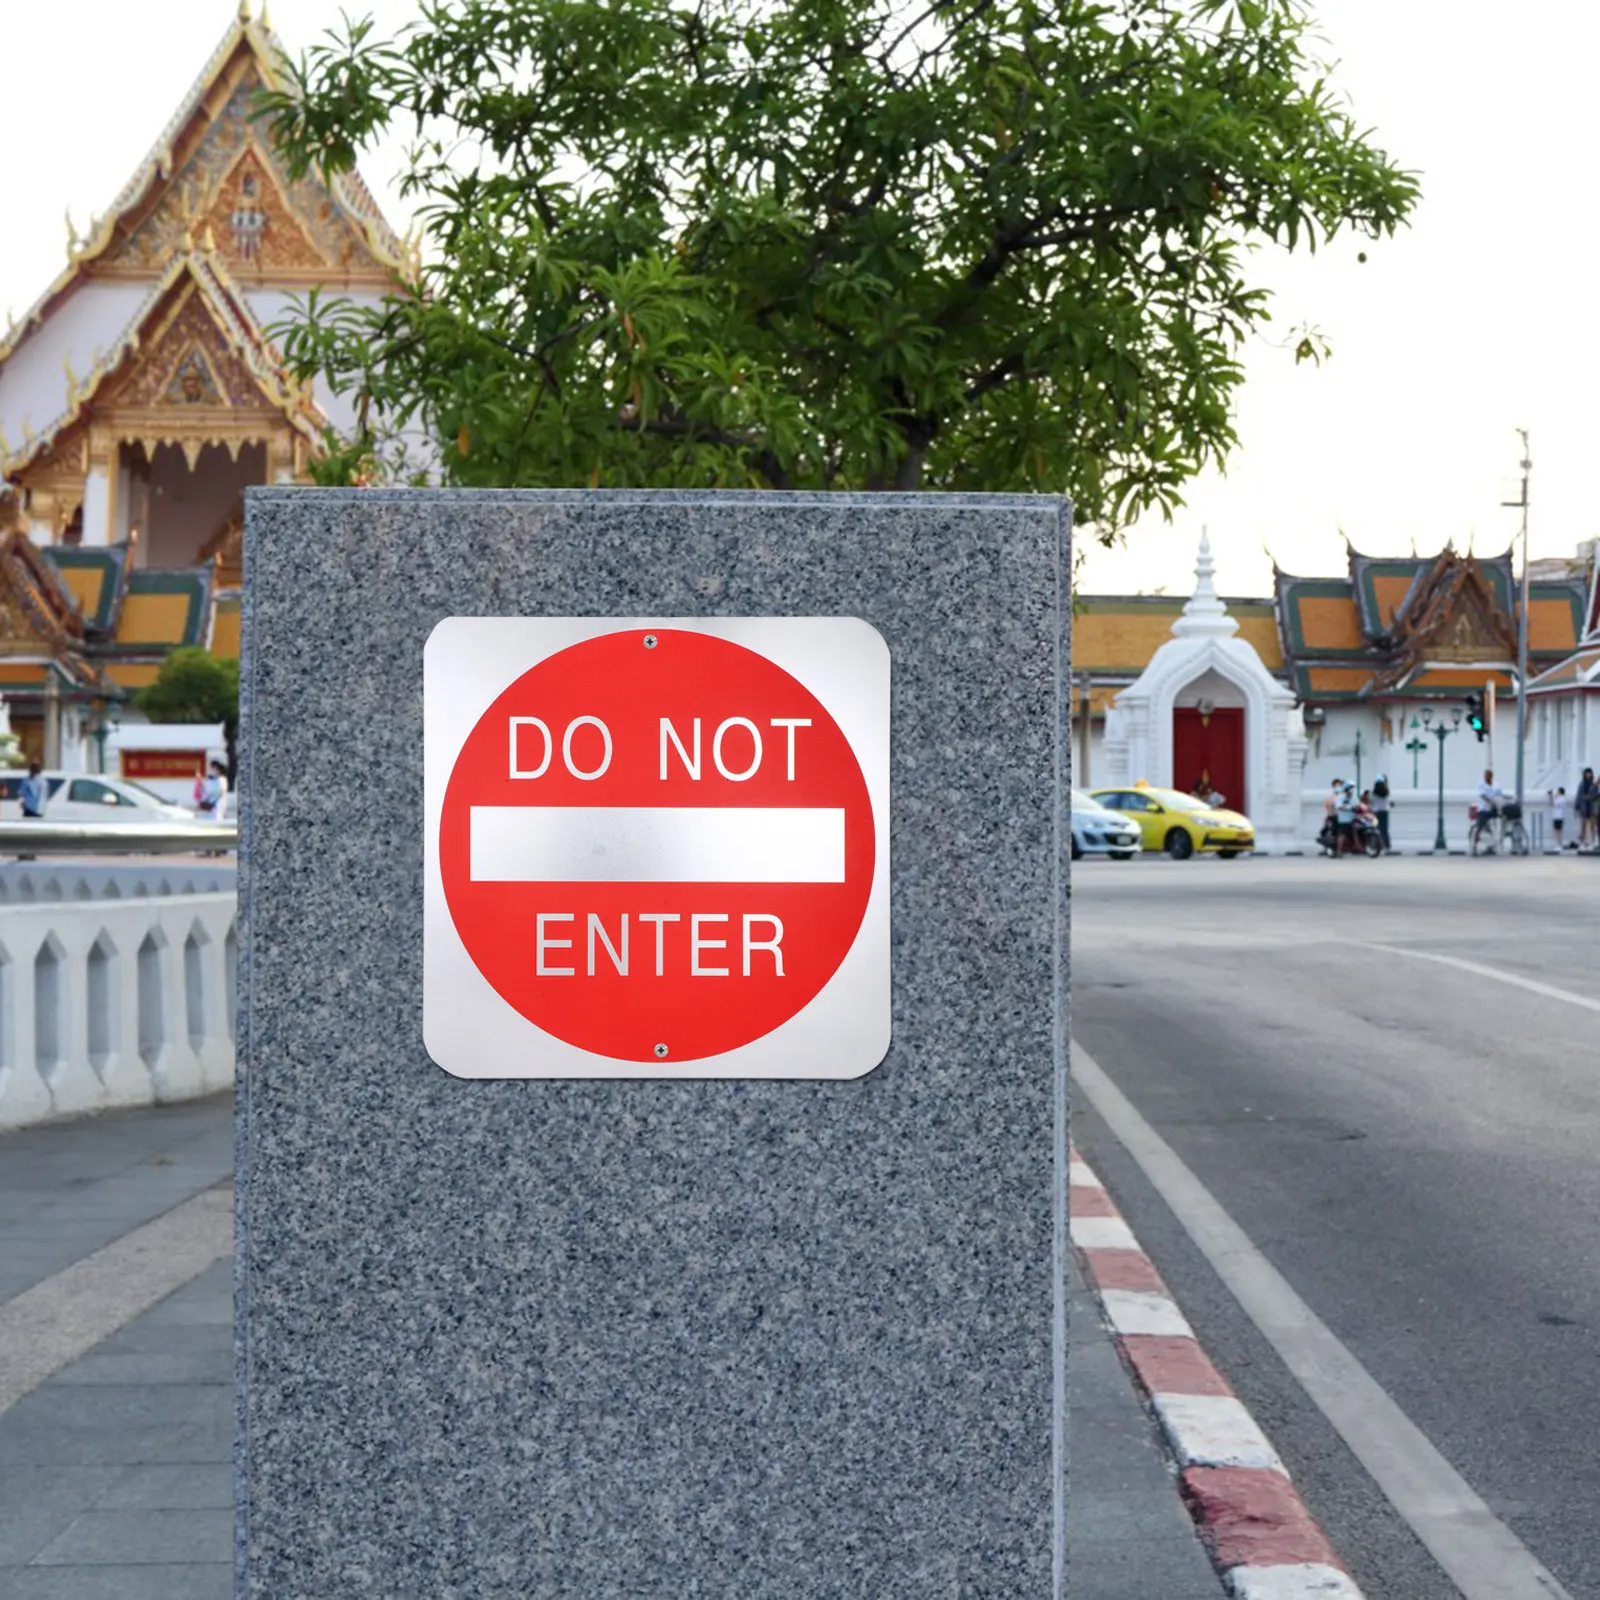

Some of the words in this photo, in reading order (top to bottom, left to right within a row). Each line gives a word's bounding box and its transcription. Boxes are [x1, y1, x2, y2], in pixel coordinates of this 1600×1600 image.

[508, 715, 613, 782] DO
[658, 716, 813, 782] NOT
[535, 912, 786, 978] ENTER
